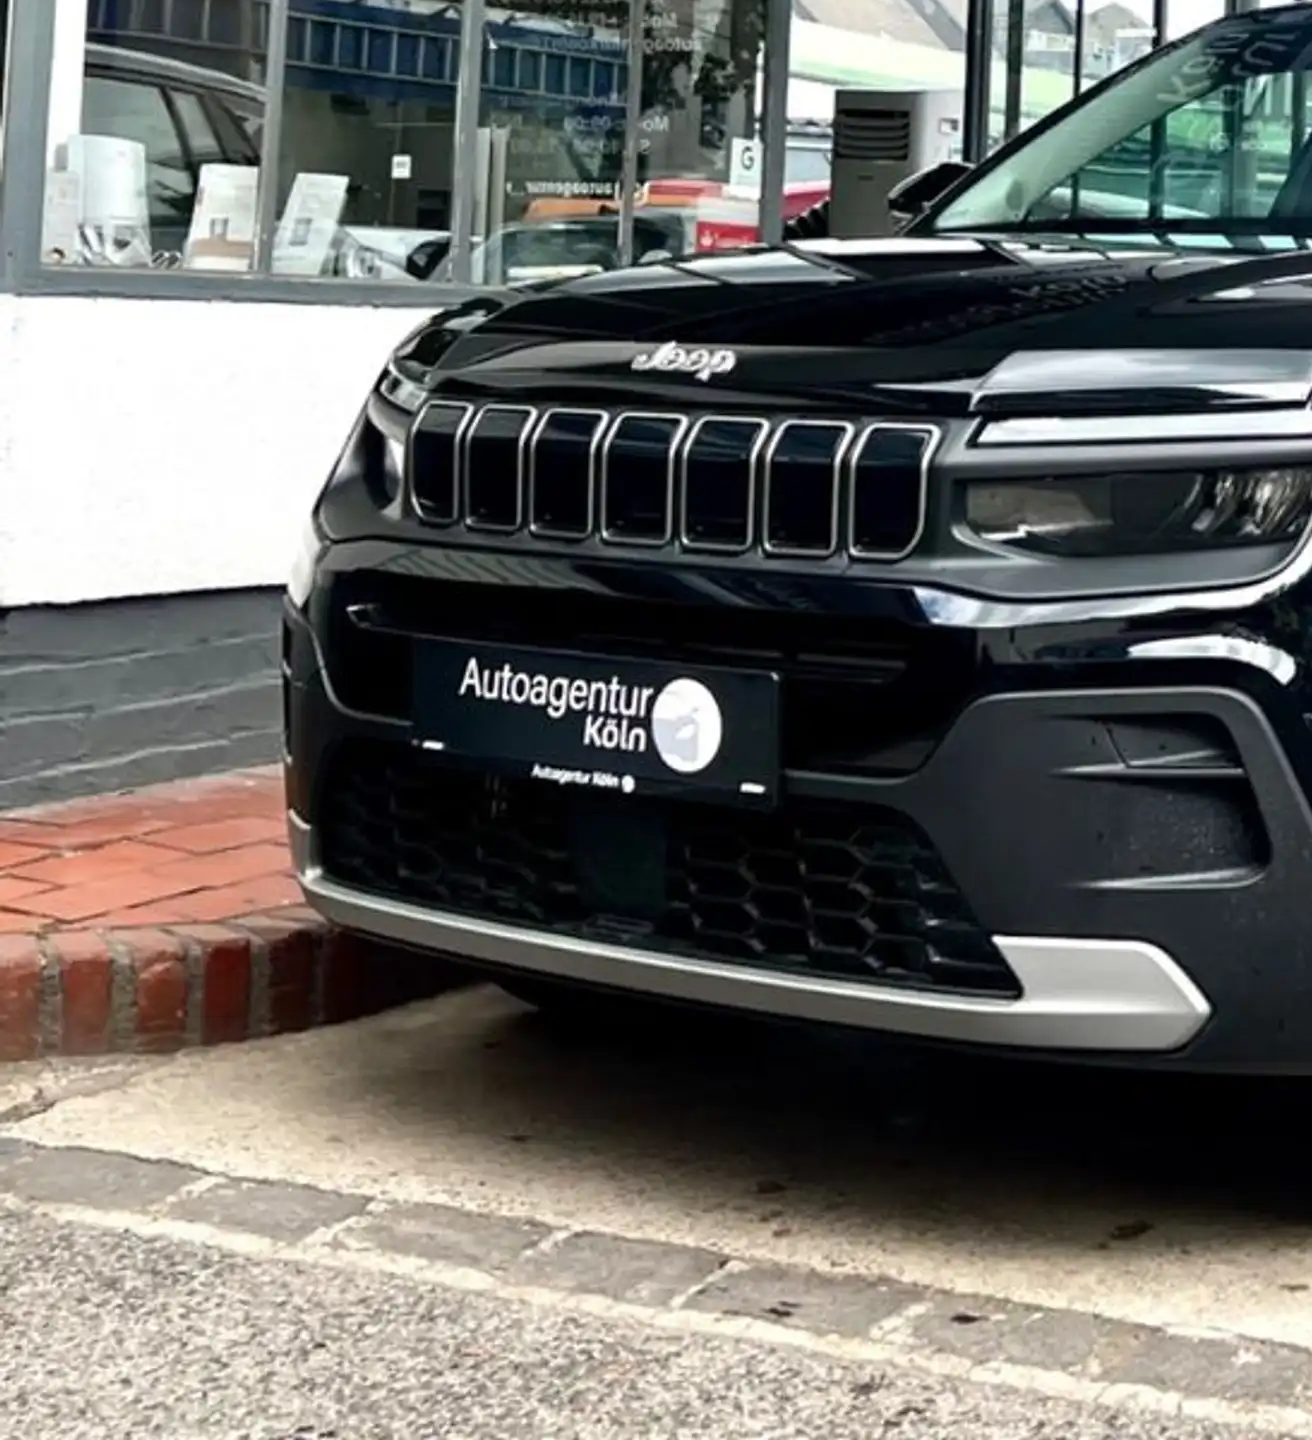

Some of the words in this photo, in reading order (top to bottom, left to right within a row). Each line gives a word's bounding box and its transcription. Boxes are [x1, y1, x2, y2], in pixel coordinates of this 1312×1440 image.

[632, 342, 737, 381] Jeep
[459, 657, 653, 718] Autoagentur
[583, 717, 648, 752] Köln
